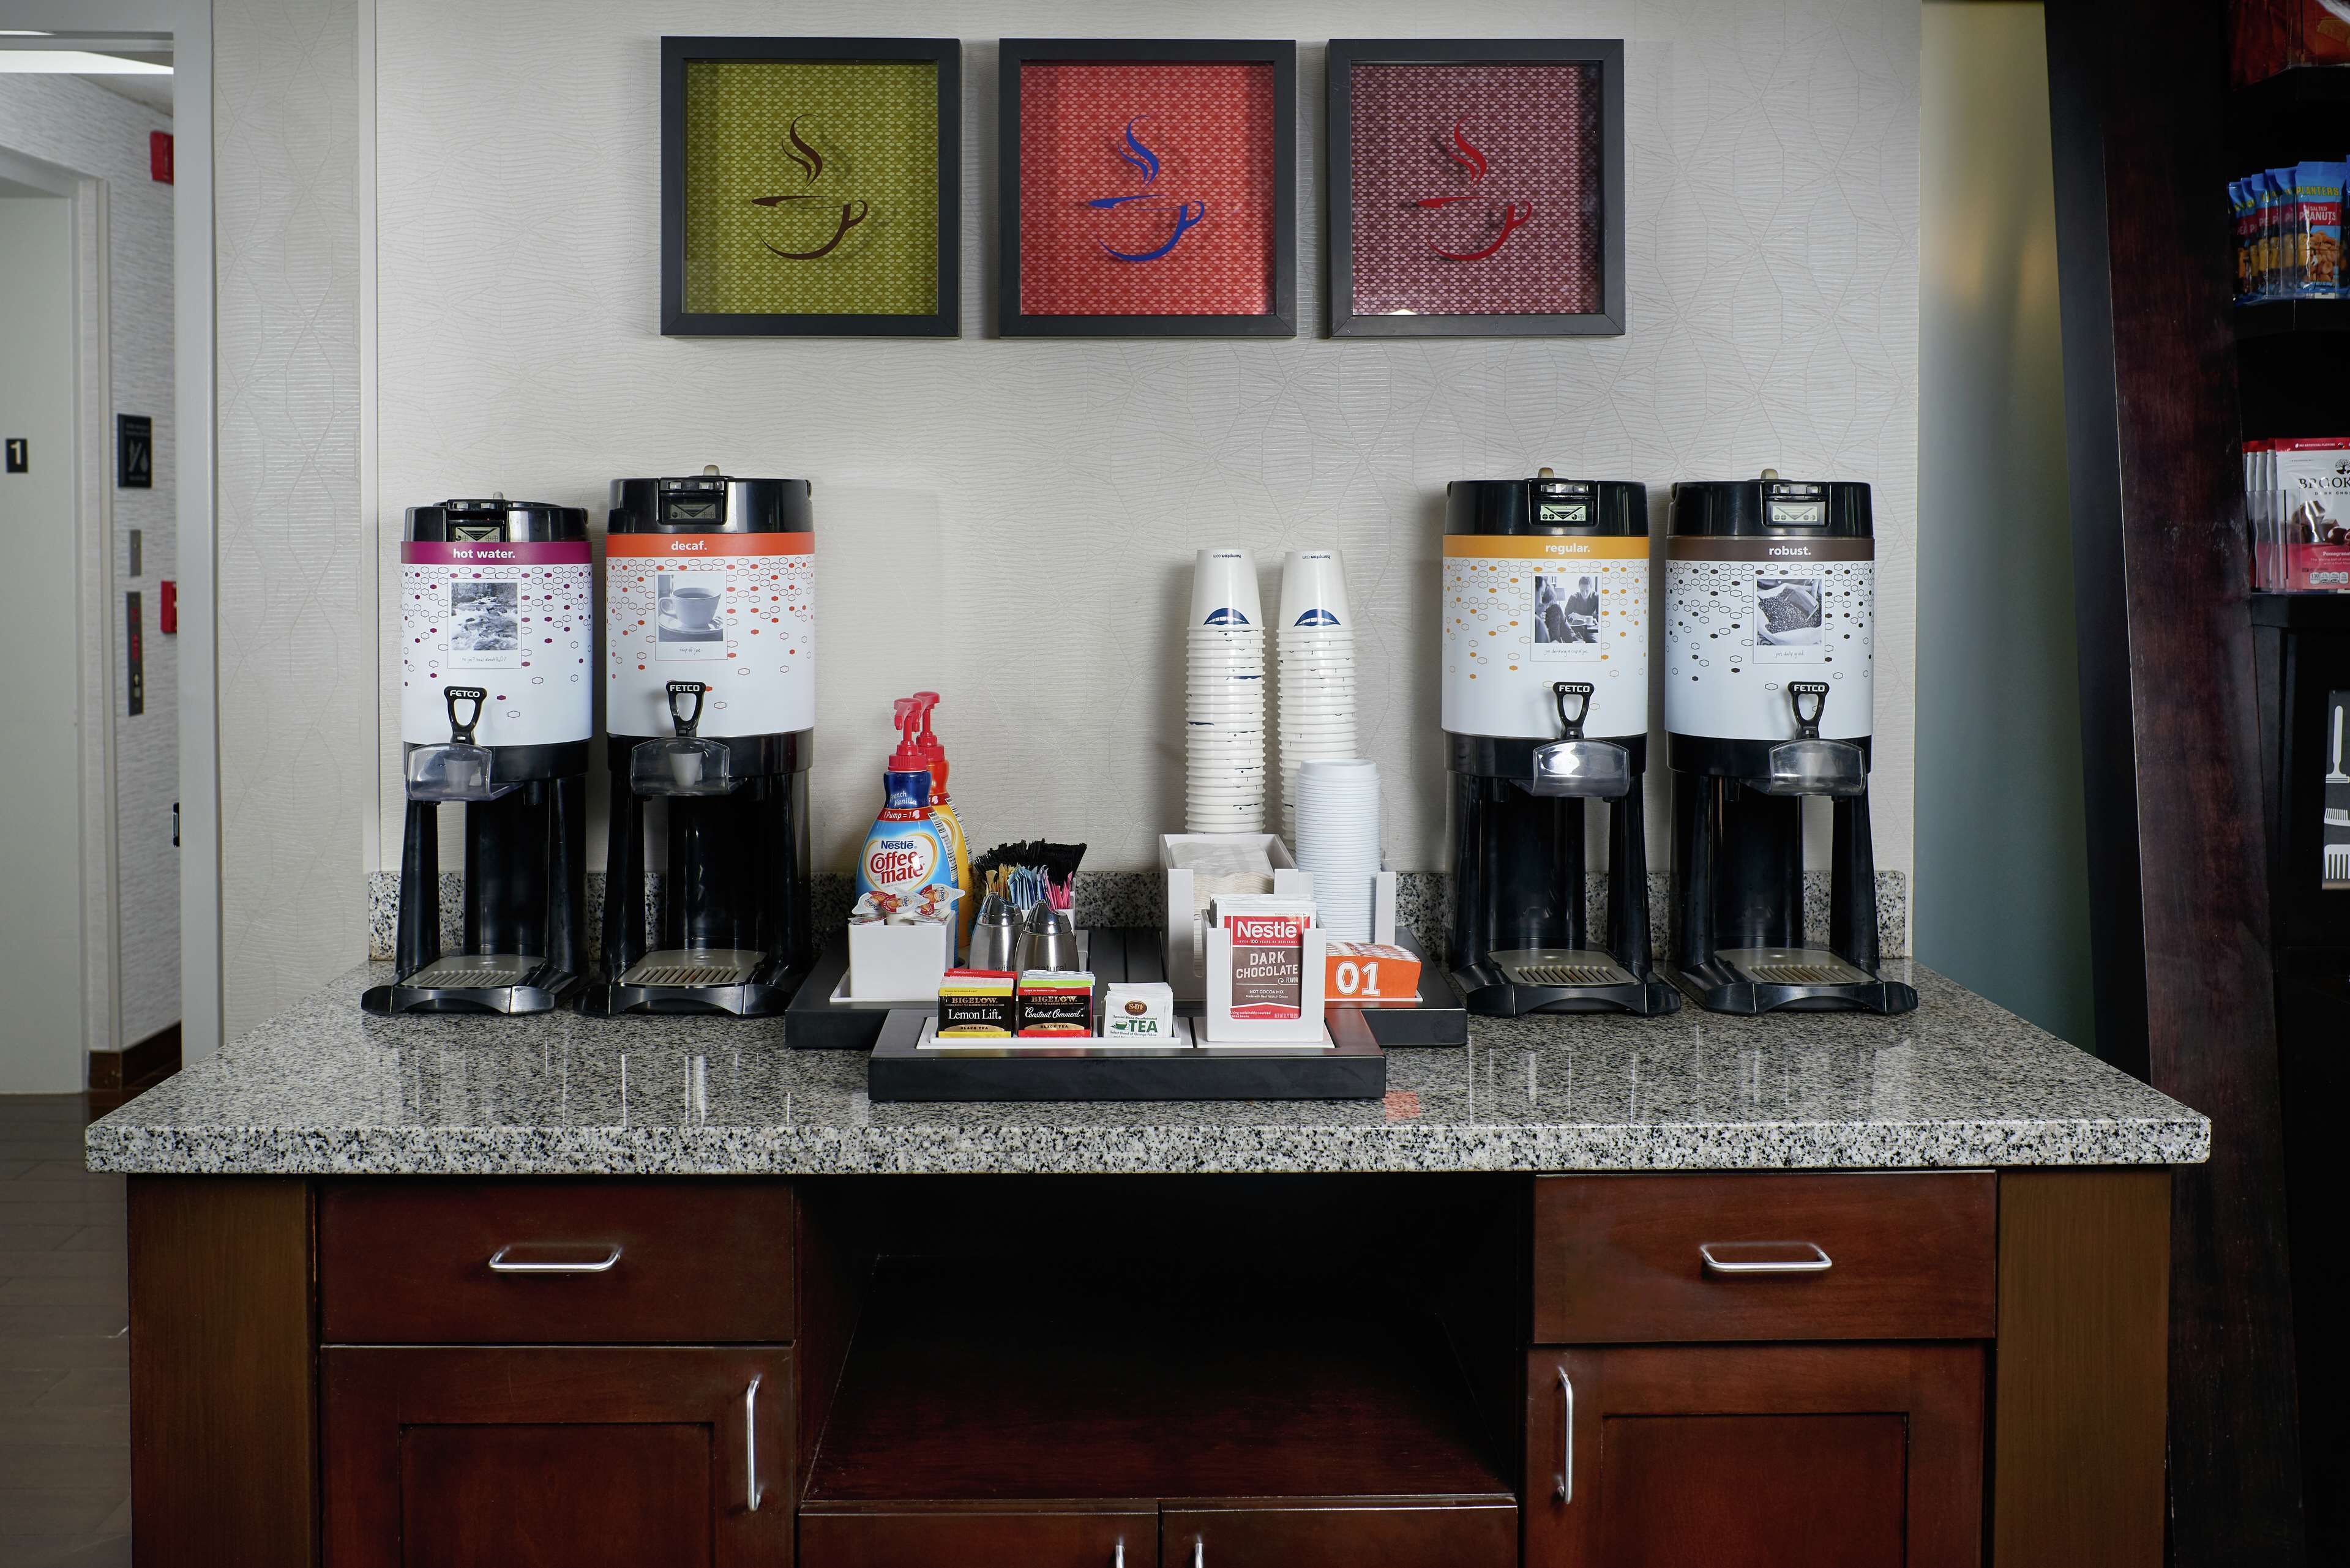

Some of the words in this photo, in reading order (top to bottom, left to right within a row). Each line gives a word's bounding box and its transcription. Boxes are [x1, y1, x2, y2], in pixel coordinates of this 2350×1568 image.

[2297, 186, 2339, 196] PLANTERS
[10, 441, 21, 464] 1
[671, 540, 708, 550] decaf.
[1545, 543, 1590, 554] regular.
[1768, 545, 1811, 555] robust.
[453, 548, 473, 558] hot
[477, 549, 515, 558] water.
[894, 797, 917, 806] Vanilla
[886, 811, 902, 820] Pump
[881, 862, 923, 884] mate
[1250, 950, 1285, 966] DARK
[1035, 963, 1066, 972] natural
[1236, 964, 1298, 979] CHOCOLATE
[1336, 961, 1380, 996] 01
[948, 1009, 979, 1020] Lemon
[1129, 1020, 1158, 1033] TEA
